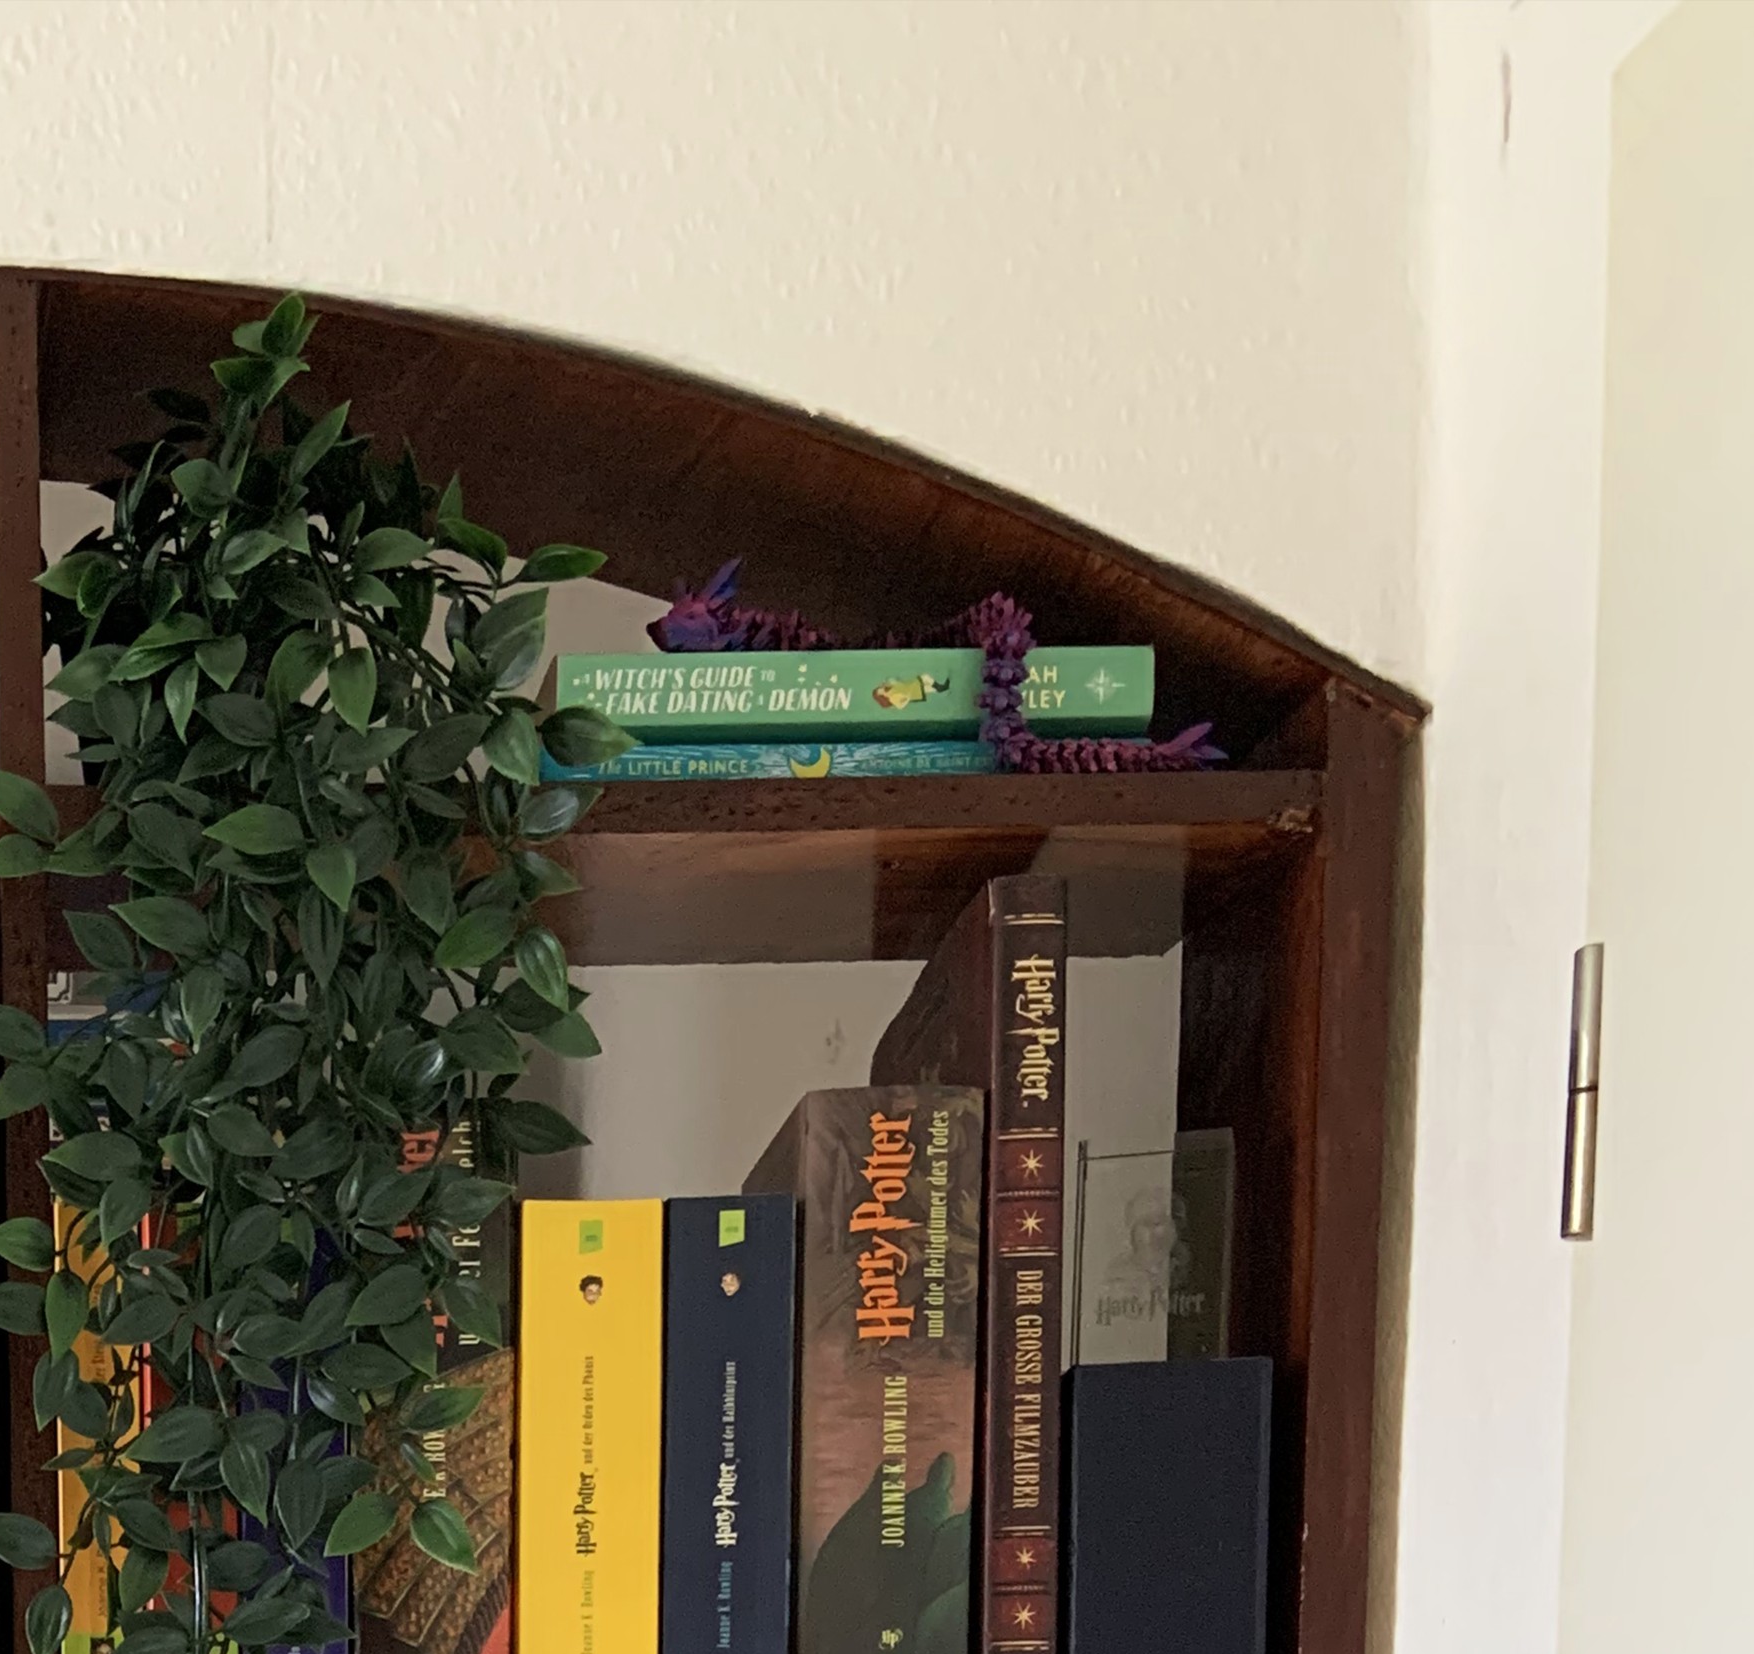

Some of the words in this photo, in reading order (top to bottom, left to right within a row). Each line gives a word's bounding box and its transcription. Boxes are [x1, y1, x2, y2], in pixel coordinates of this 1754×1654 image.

[593, 667, 687, 691] WITCH'S
[690, 667, 753, 689] GUIDE
[607, 691, 661, 715] FAKE
[668, 690, 753, 713] DATING
[769, 688, 851, 713] DEMON
[628, 760, 682, 775] LITTLE
[687, 759, 748, 774] PRINCE
[926, 1110, 949, 1153] Todes
[850, 1112, 921, 1233] Potter
[927, 1160, 948, 1184] des
[924, 1190, 949, 1277] Heiligtümer
[856, 1235, 915, 1346] Harry
[924, 1282, 944, 1305] die
[1016, 1269, 1044, 1306] DER
[924, 1309, 944, 1339] und
[1015, 1314, 1044, 1387] GROSSE
[881, 1375, 907, 1457] ROWLING
[1012, 1395, 1042, 1510] FILMZAUBER
[881, 1481, 906, 1550] JOANNE
